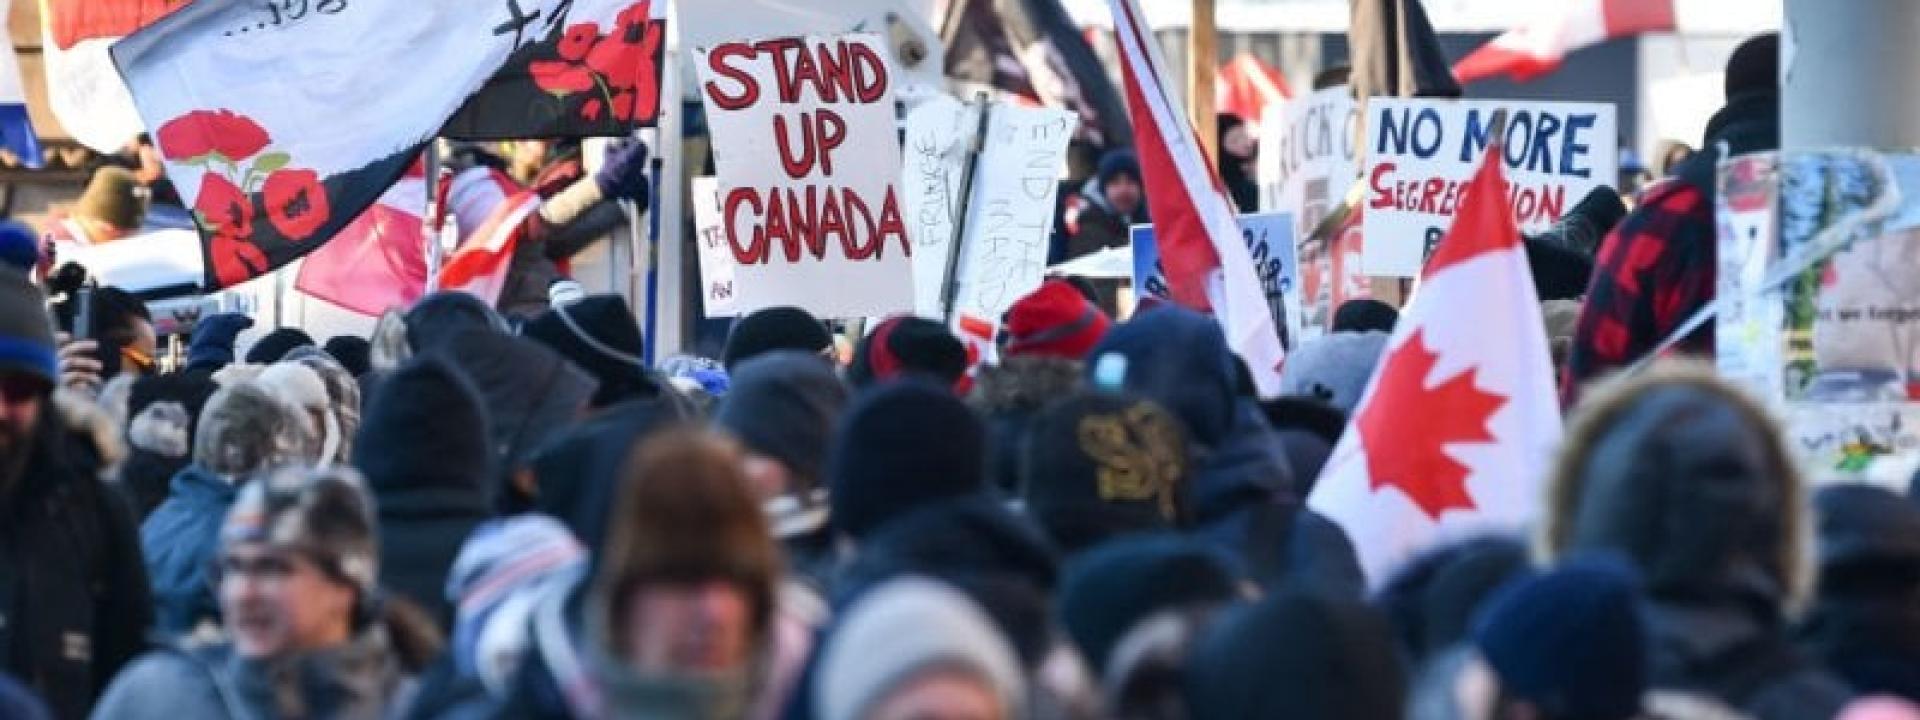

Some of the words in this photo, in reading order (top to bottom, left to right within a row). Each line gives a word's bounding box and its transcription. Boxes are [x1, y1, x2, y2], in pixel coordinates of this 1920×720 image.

[705, 36, 888, 110] STAND
[773, 107, 847, 179] UP
[1377, 107, 1442, 158] NO
[1459, 107, 1597, 178] MORE
[724, 183, 911, 264] CANADA
